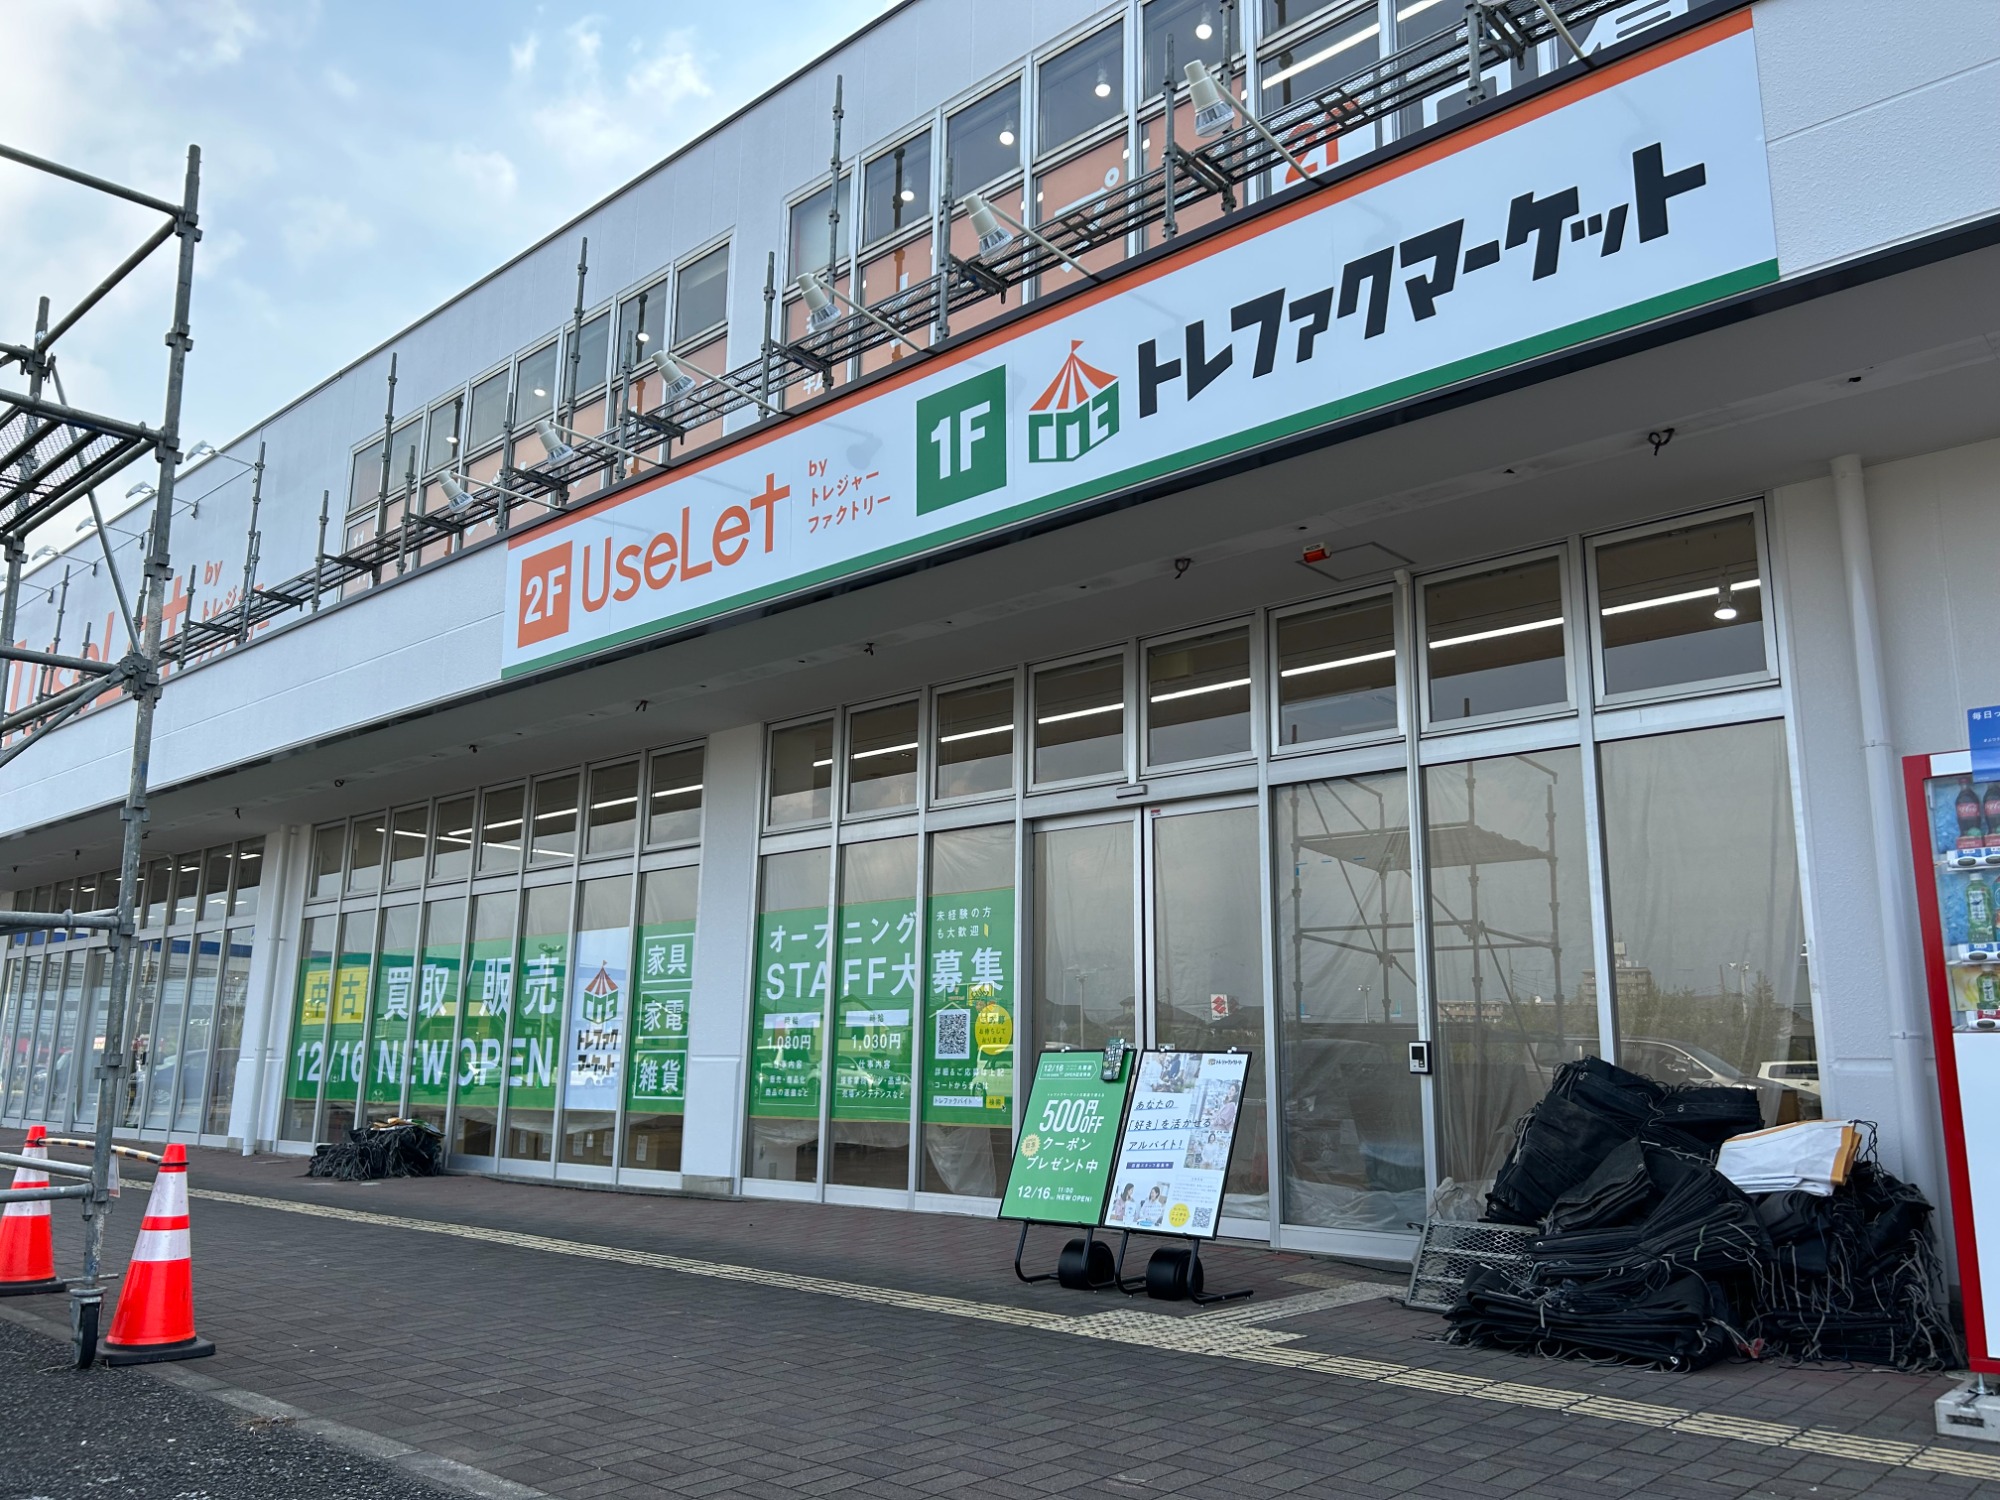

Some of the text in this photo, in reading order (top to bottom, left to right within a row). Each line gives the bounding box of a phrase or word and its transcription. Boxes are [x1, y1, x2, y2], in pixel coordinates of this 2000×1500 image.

[1138, 142, 1706, 418] トレファクマーケット
[931, 400, 990, 480] 1F
[808, 459, 828, 477] by
[811, 471, 879, 507] トレジャー
[808, 496, 891, 534] ファクトリー
[524, 565, 567, 625] 2F
[582, 473, 791, 613] UseLet
[203, 560, 223, 586] by
[936, 906, 992, 921] 未経験の方
[769, 912, 918, 953] オープニング
[937, 925, 979, 939] も大歓迎
[647, 944, 688, 976] 家具
[643, 999, 684, 1031] 家電
[577, 1029, 619, 1050] トレファク
[767, 1034, 812, 1051] 1,080円
[852, 1033, 901, 1051] 1,030円
[298, 1038, 554, 1087] 12/16 NEW OPEN
[639, 1059, 682, 1092] 雑貨
[1136, 1099, 1175, 1109] あなたの
[1079, 1115, 1104, 1133] OFF
[1043, 1136, 1092, 1151] クーポン
[1026, 1155, 1099, 1174] プレゼント中
[1018, 1185, 1051, 1199] 12/16
